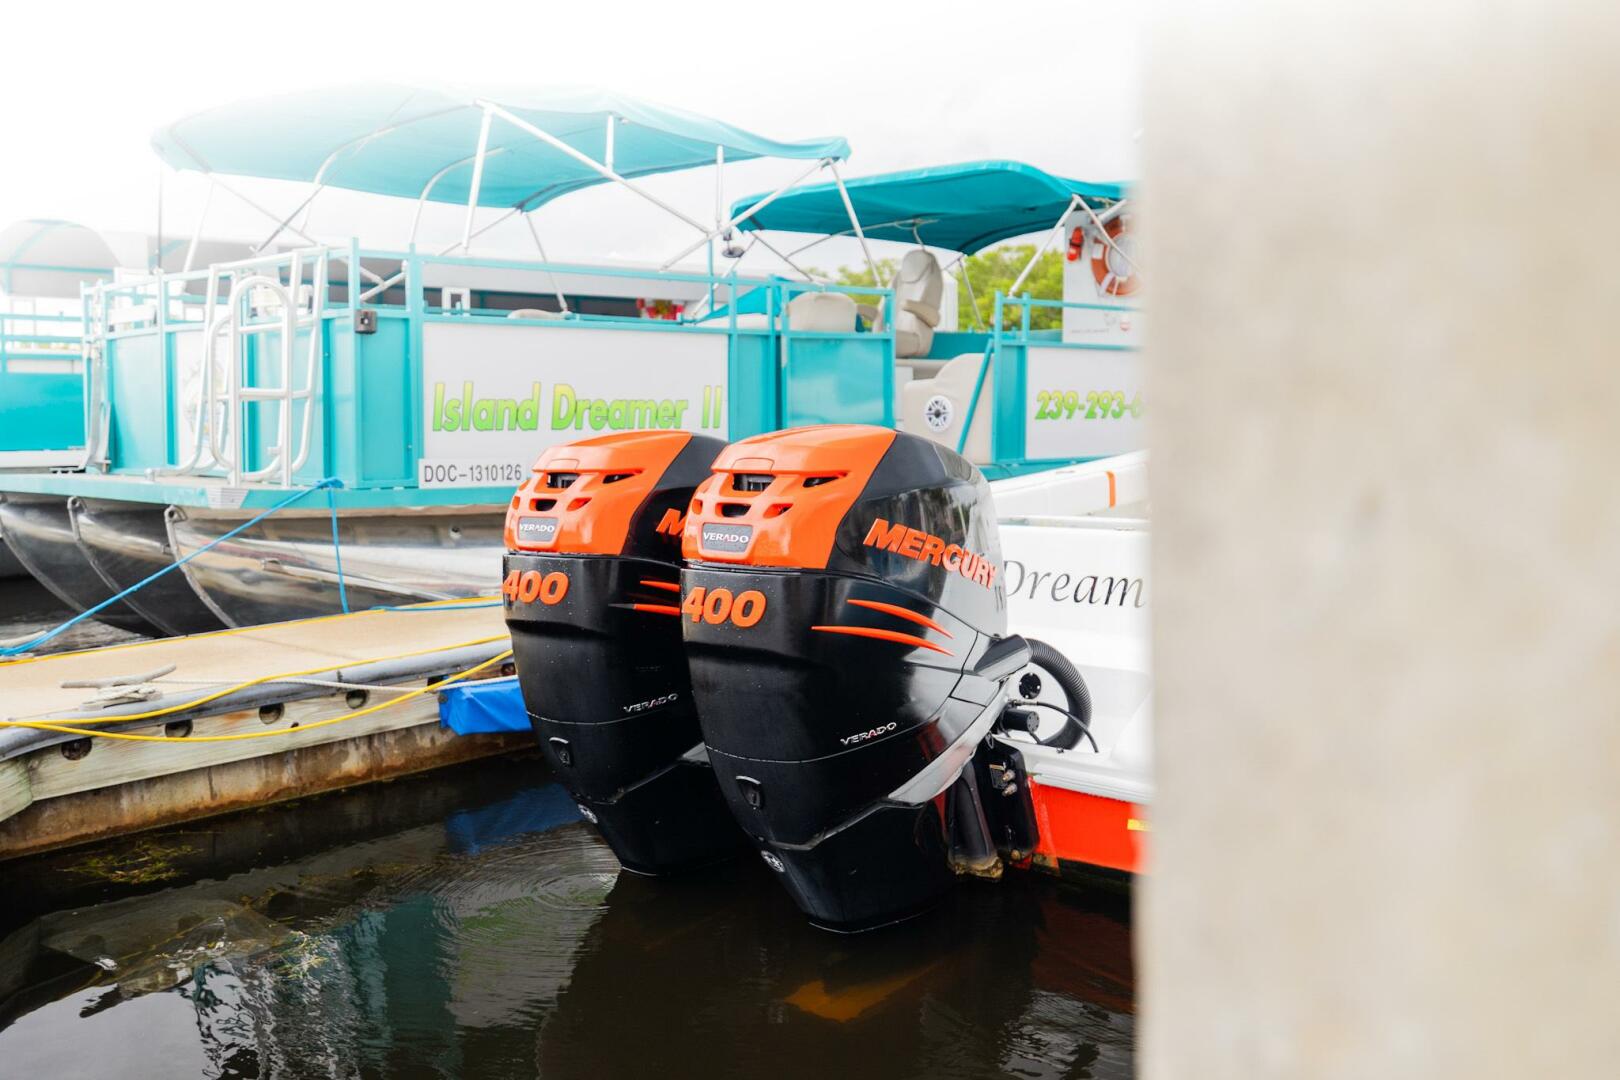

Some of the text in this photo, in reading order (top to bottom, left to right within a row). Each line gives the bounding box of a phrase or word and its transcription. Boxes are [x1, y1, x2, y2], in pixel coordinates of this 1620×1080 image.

[432, 381, 541, 431] Island
[551, 383, 688, 430] Dreamer
[424, 464, 522, 482] DOC-1310126
[519, 522, 555, 533] VERADO
[703, 532, 750, 544] VERADO
[862, 517, 996, 590] MERCURY
[503, 569, 569, 605] 400
[682, 586, 767, 628] 400
[623, 693, 679, 713] VERADO
[840, 722, 897, 746] VERADO
